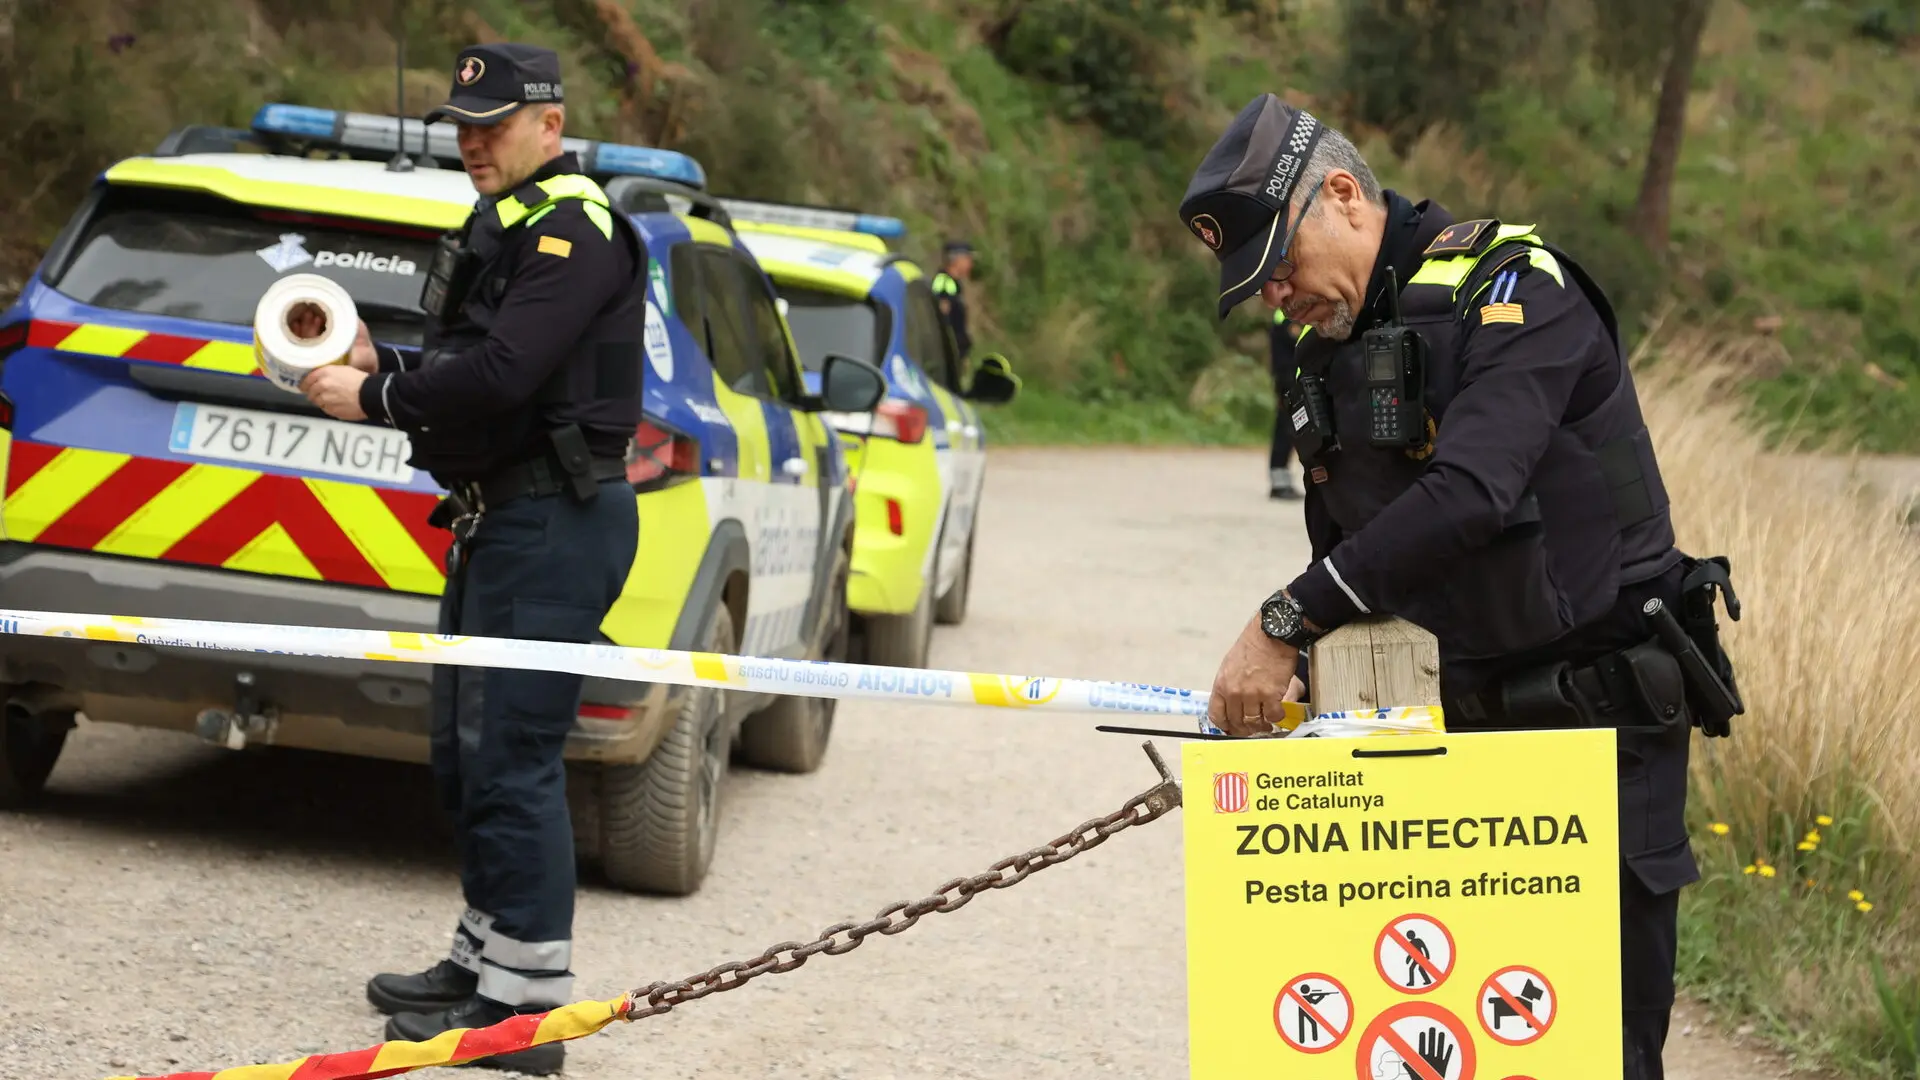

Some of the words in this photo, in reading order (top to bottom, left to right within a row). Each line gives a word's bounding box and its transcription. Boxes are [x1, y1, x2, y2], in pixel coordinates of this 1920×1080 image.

[1266, 154, 1295, 198] POLICIA
[313, 250, 416, 276] policia
[201, 413, 309, 459] 7617
[321, 428, 403, 475] NGH
[1256, 771, 1364, 789] Generalitat
[1256, 795, 1280, 811] de
[1286, 793, 1384, 812] Catalunya
[1236, 822, 1350, 856] ZONA
[1361, 814, 1589, 851] INFECTADA
[1245, 879, 1328, 905] Pesta
[1338, 874, 1451, 907] porcina
[1461, 871, 1581, 897] africana
